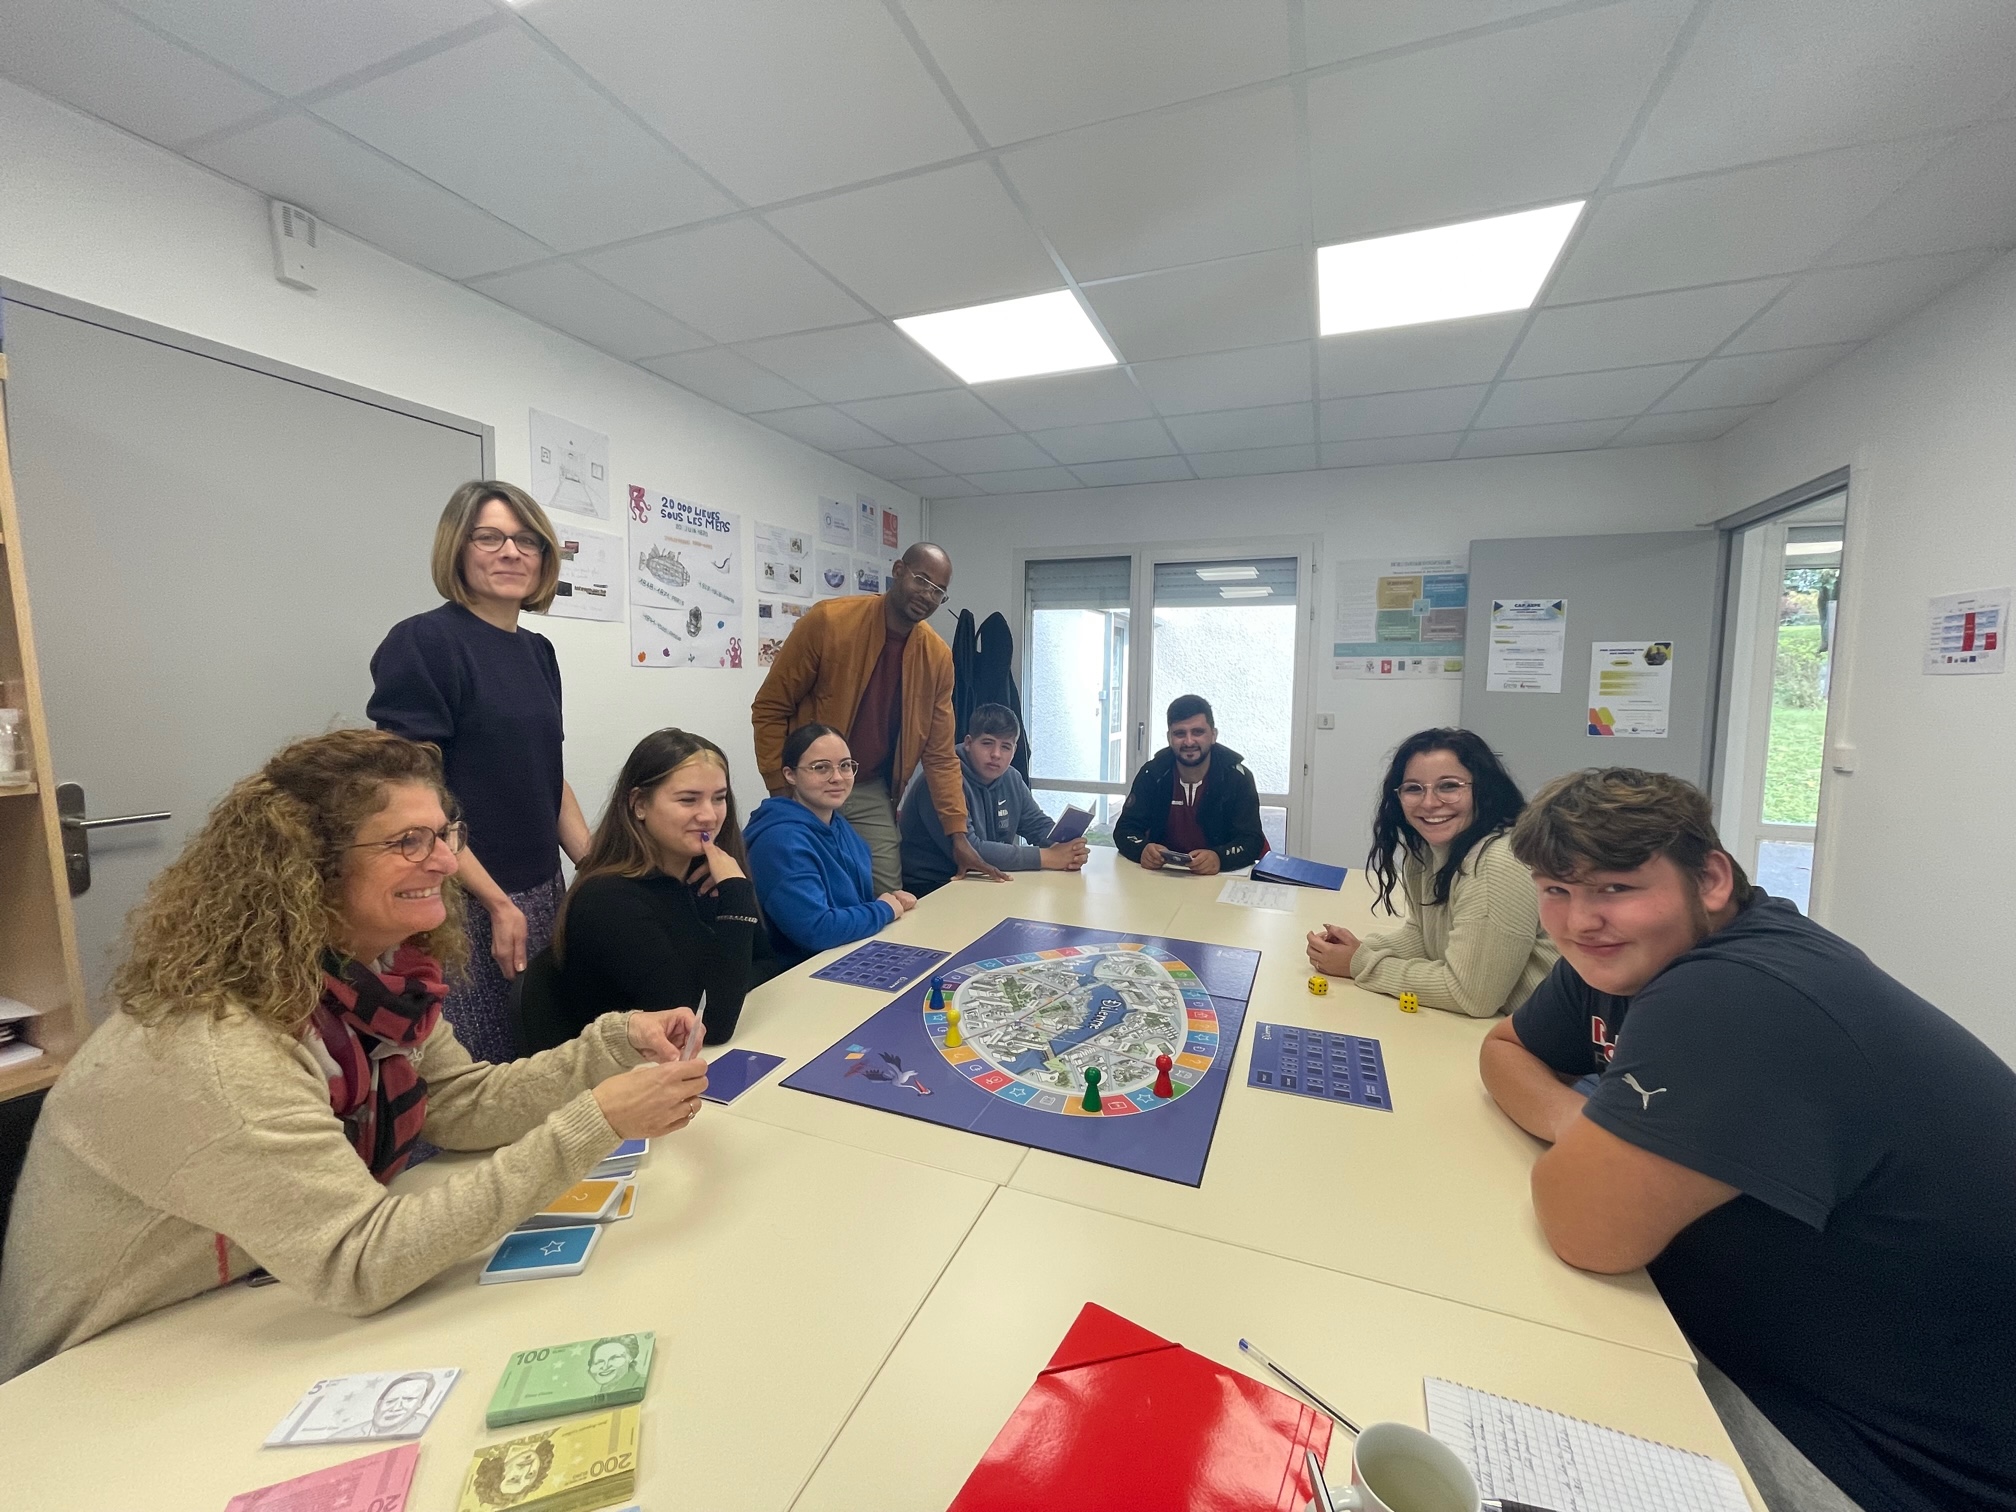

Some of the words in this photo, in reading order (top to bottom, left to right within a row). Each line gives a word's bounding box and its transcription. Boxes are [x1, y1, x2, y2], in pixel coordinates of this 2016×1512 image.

[661, 496, 675, 509] 20
[677, 502, 693, 514] 000
[660, 509, 683, 522] SOUS
[687, 515, 703, 527] LES
[705, 518, 731, 532] MERS
[516, 1348, 550, 1366] 100
[307, 1379, 327, 1395] 5
[589, 1452, 633, 1478] 200
[367, 1493, 402, 1512] 20
